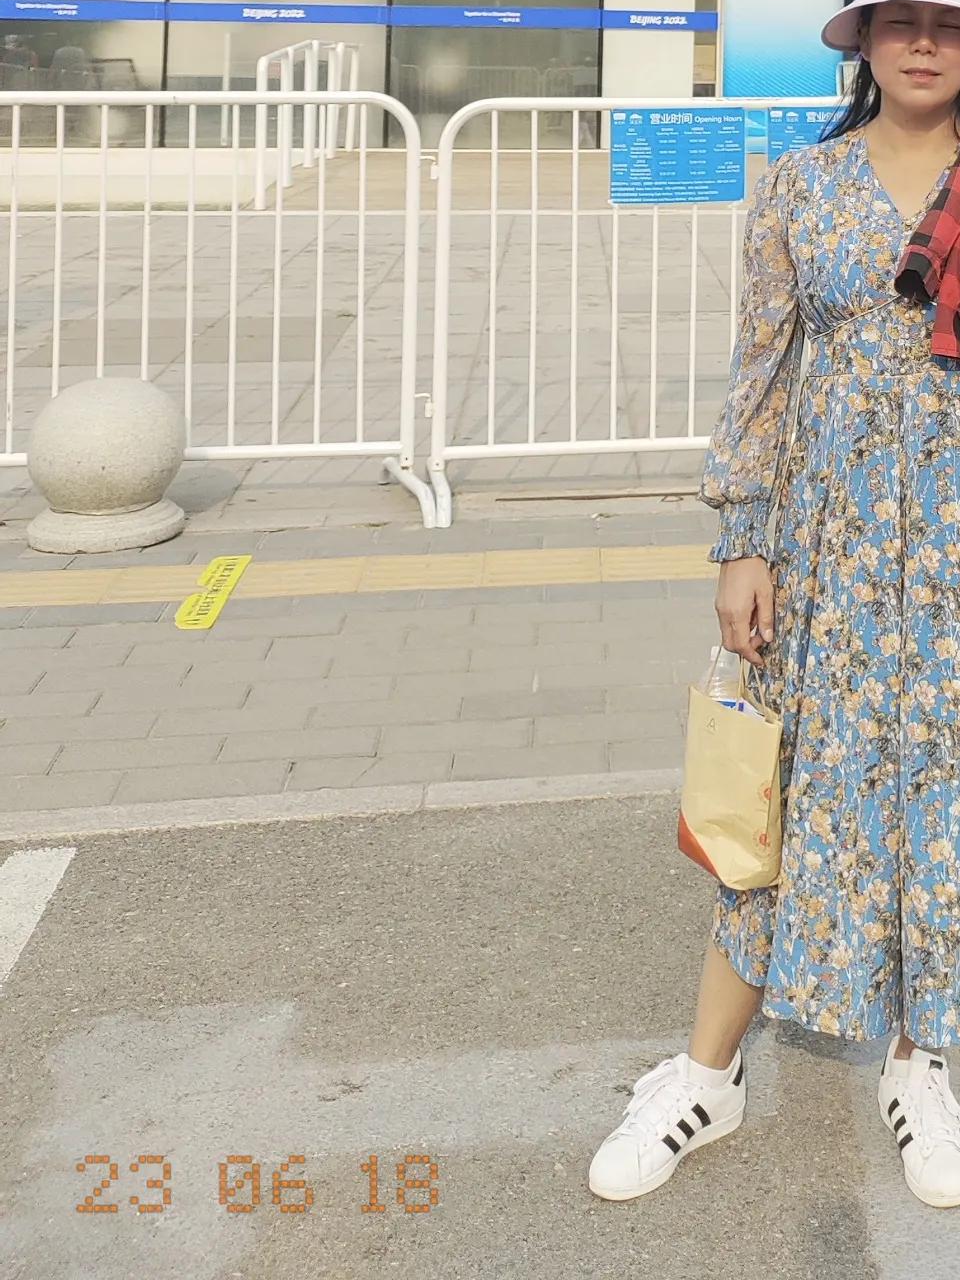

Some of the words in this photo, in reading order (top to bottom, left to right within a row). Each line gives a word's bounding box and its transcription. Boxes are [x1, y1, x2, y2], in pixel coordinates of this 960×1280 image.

[630, 15, 661, 26] BEIJING
[663, 16, 688, 25] 2022
[649, 112, 692, 124] 营业时间
[694, 115, 722, 124] Opening
